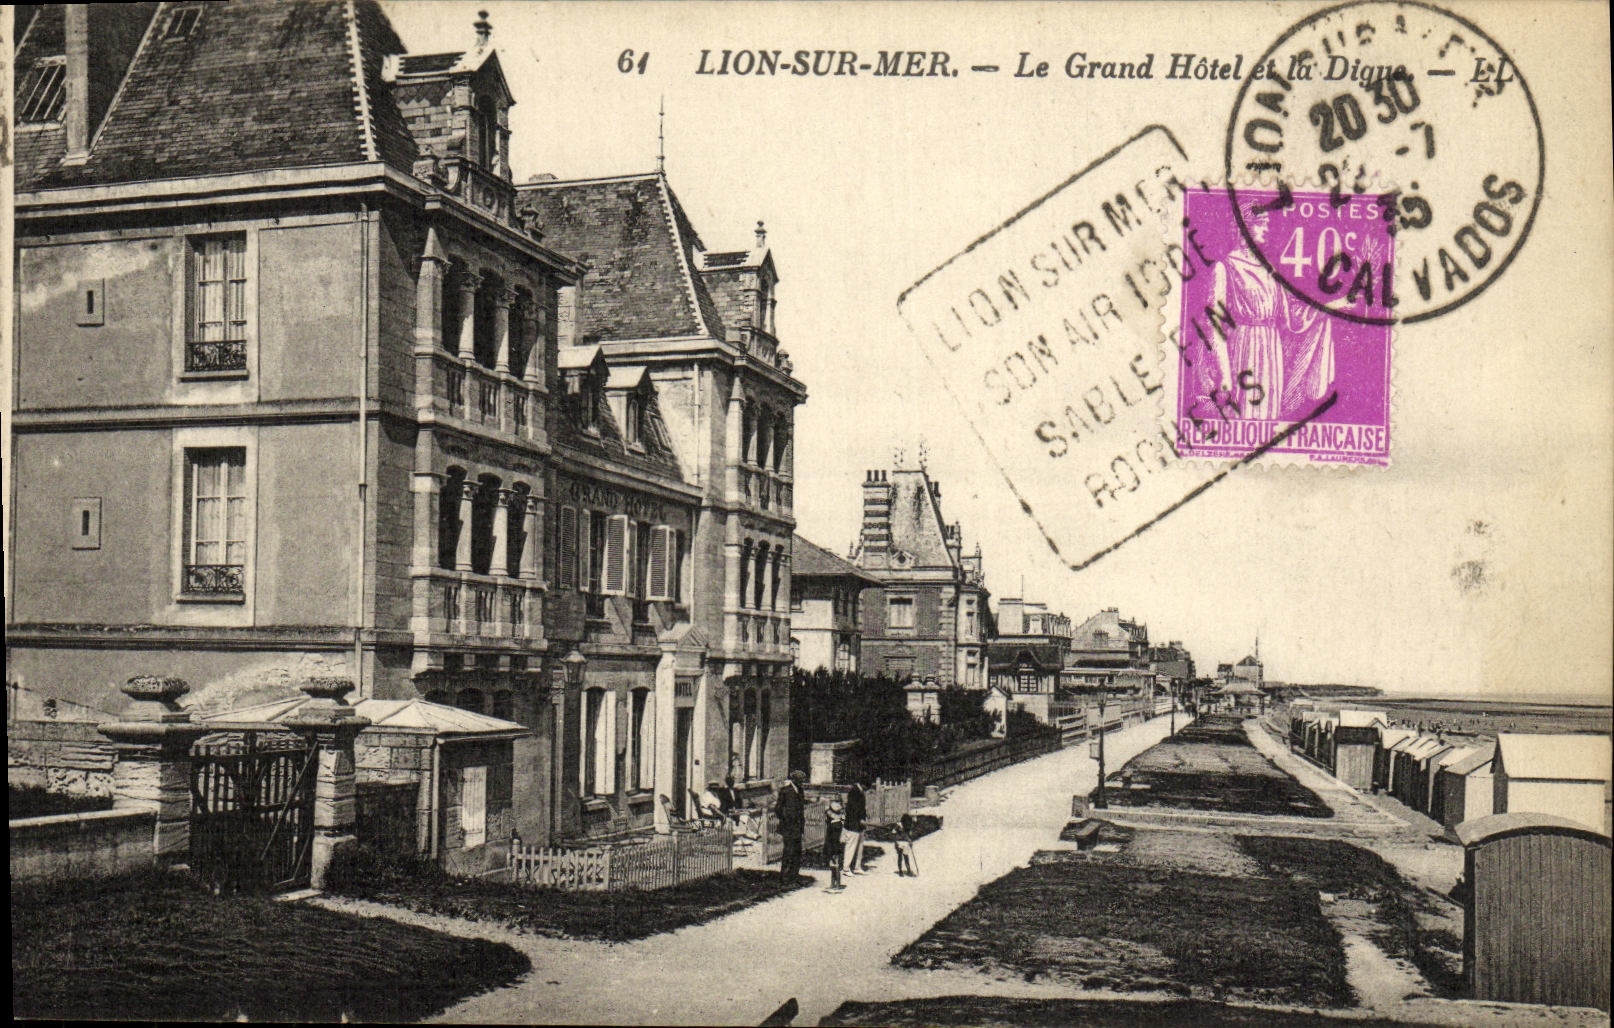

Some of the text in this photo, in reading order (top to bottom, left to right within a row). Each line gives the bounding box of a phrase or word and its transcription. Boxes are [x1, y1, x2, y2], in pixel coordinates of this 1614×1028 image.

[1309, 92, 1367, 152] 20
[1282, 203, 1379, 220] POSTES
[1035, 300, 1236, 458] SABLE FIN
[1286, 422, 1385, 452] FRANÇAISE
